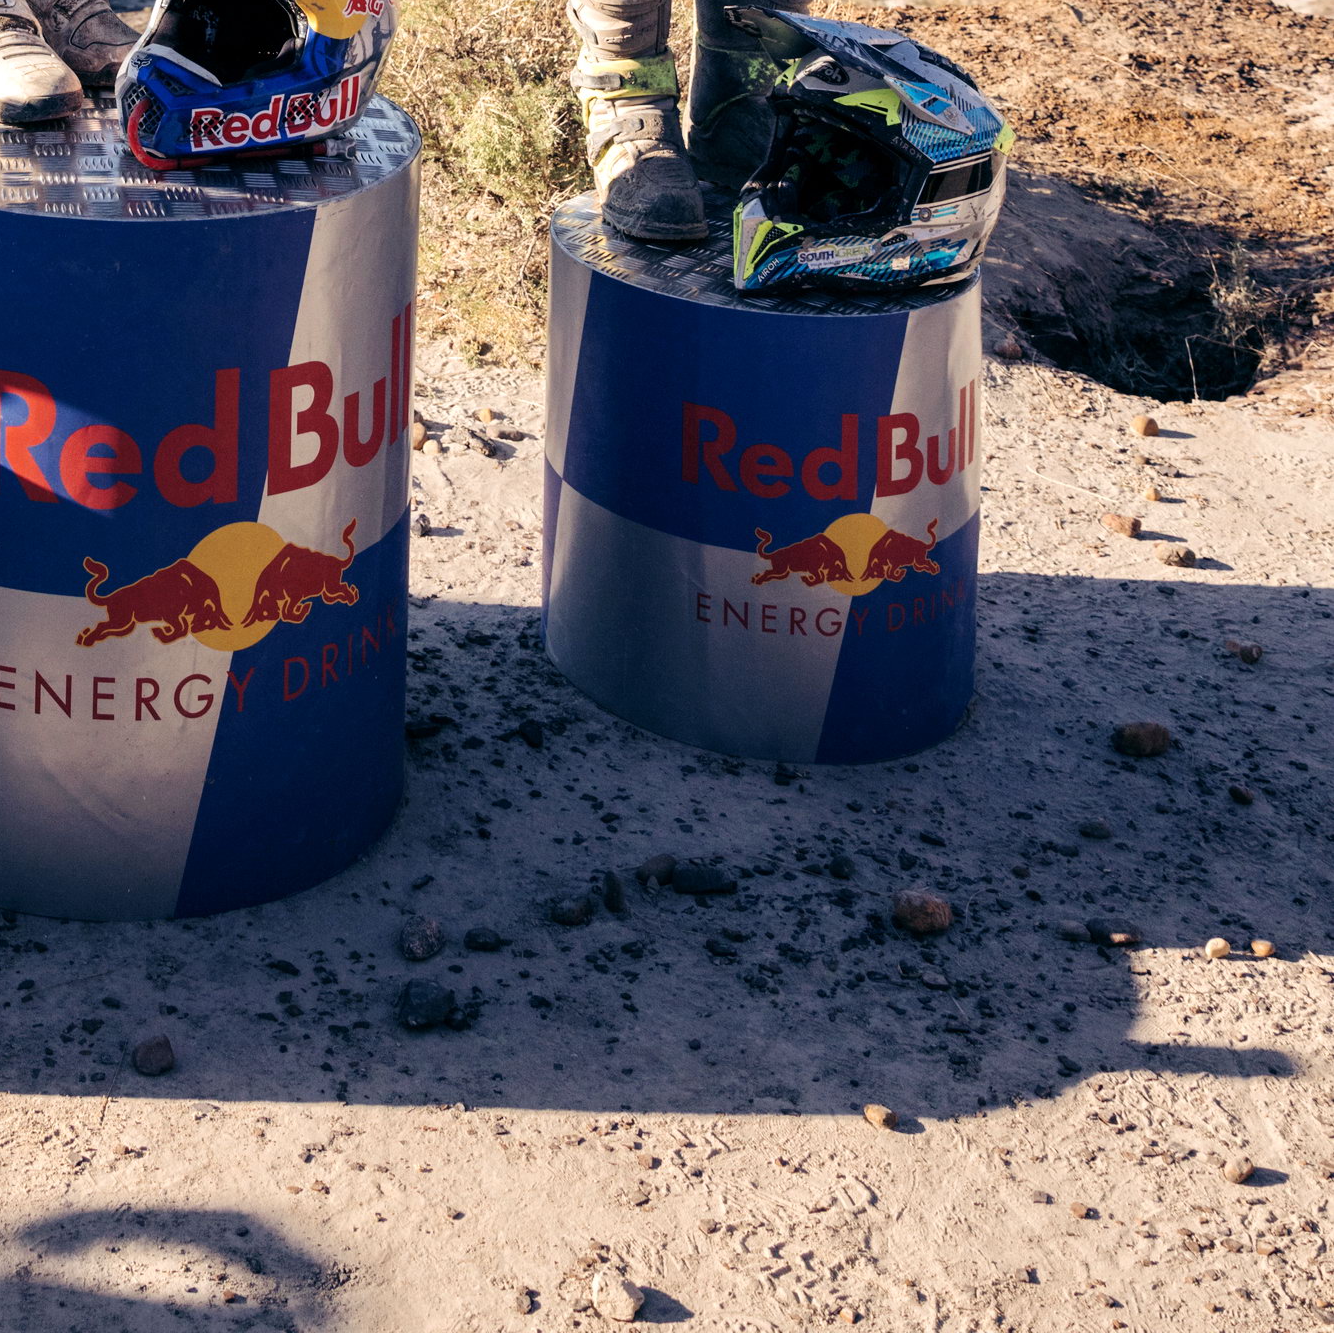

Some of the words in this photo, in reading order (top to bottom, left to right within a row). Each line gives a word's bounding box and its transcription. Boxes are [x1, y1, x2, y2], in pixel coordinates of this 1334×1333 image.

[190, 94, 283, 151] Red
[284, 74, 361, 137] Bull
[757, 257, 780, 283] AIROH
[798, 250, 835, 264] SOUTH
[267, 301, 412, 496] Bull
[681, 400, 859, 501] Red
[875, 378, 976, 499] Bull
[696, 593, 868, 637] ENERGY
[887, 579, 966, 632] DRINK
[283, 595, 401, 702] DRINK
